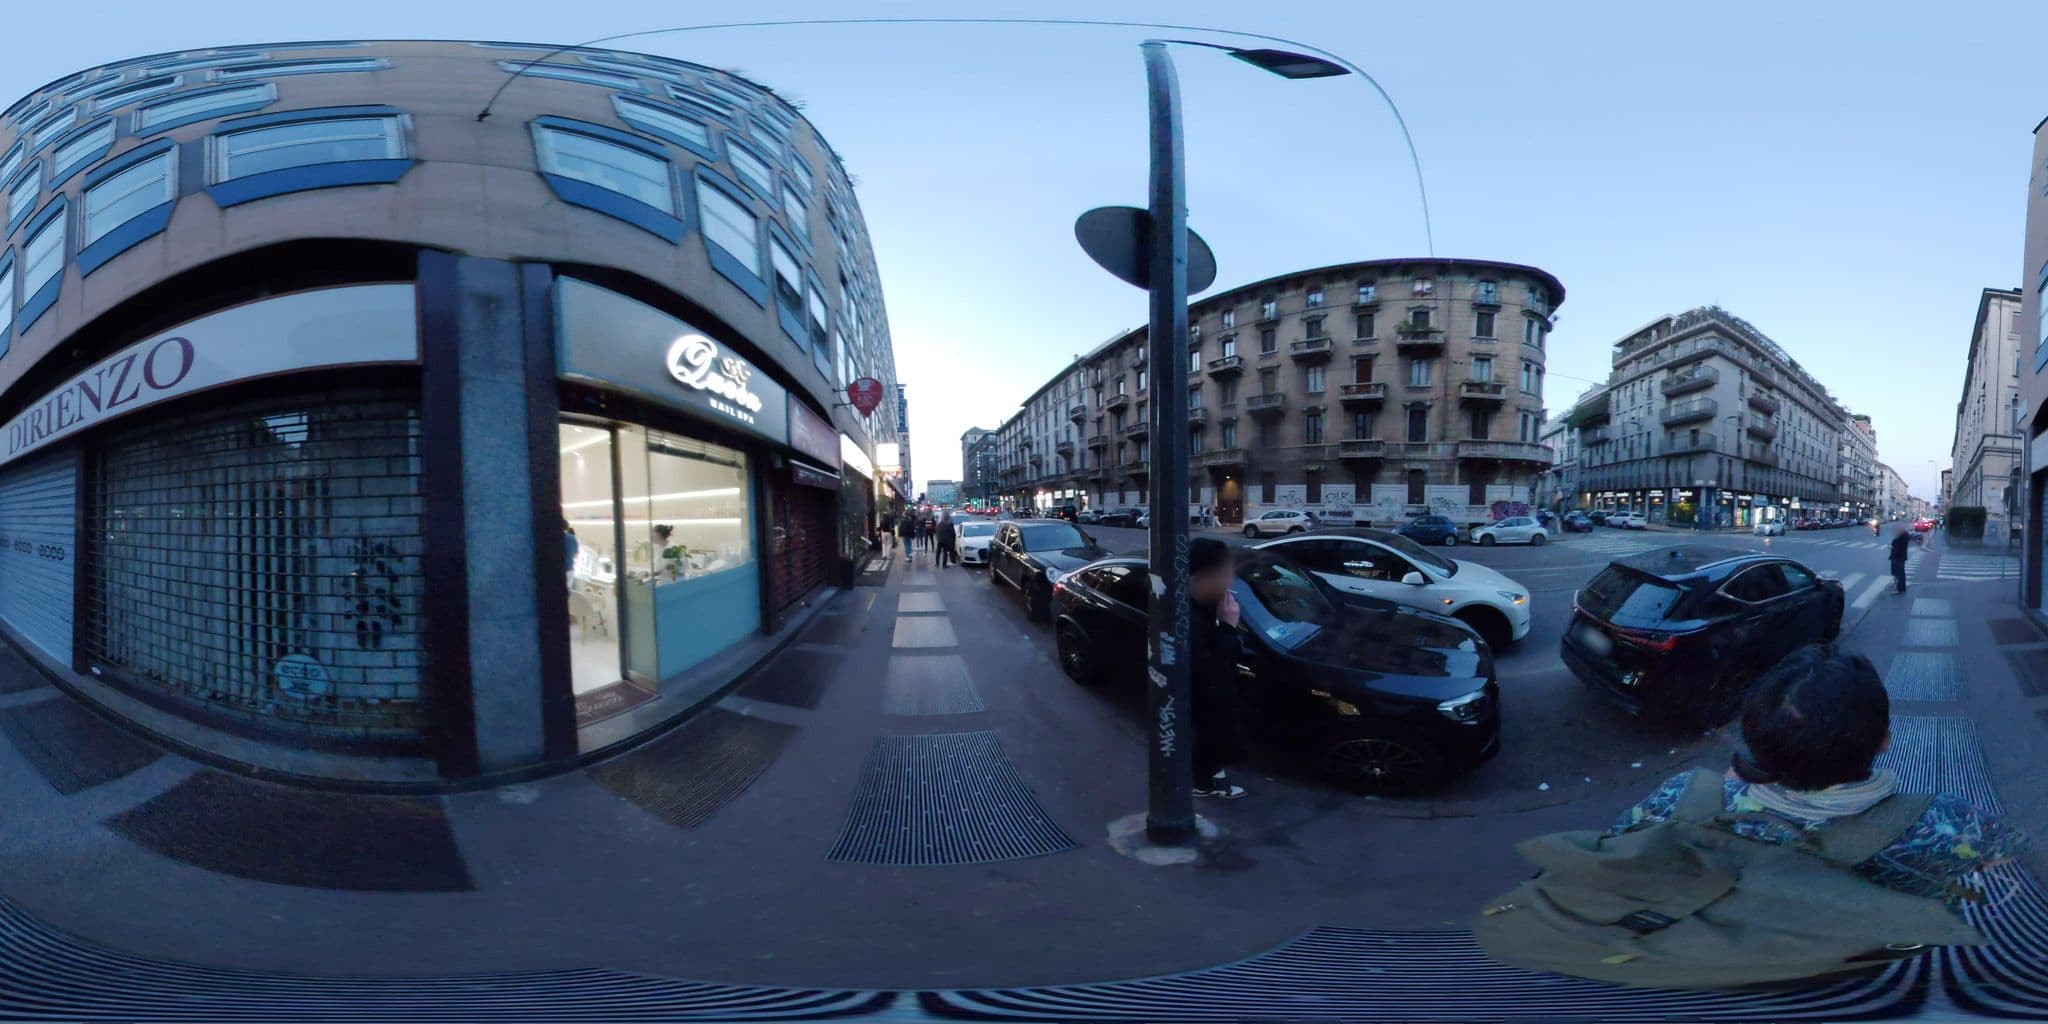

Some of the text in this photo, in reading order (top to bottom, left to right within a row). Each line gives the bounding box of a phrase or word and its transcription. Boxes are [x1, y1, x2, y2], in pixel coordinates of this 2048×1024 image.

[8, 336, 195, 455] DIRIENZO
[708, 397, 736, 417] NAIL
[39, 544, 65, 561] ecco
